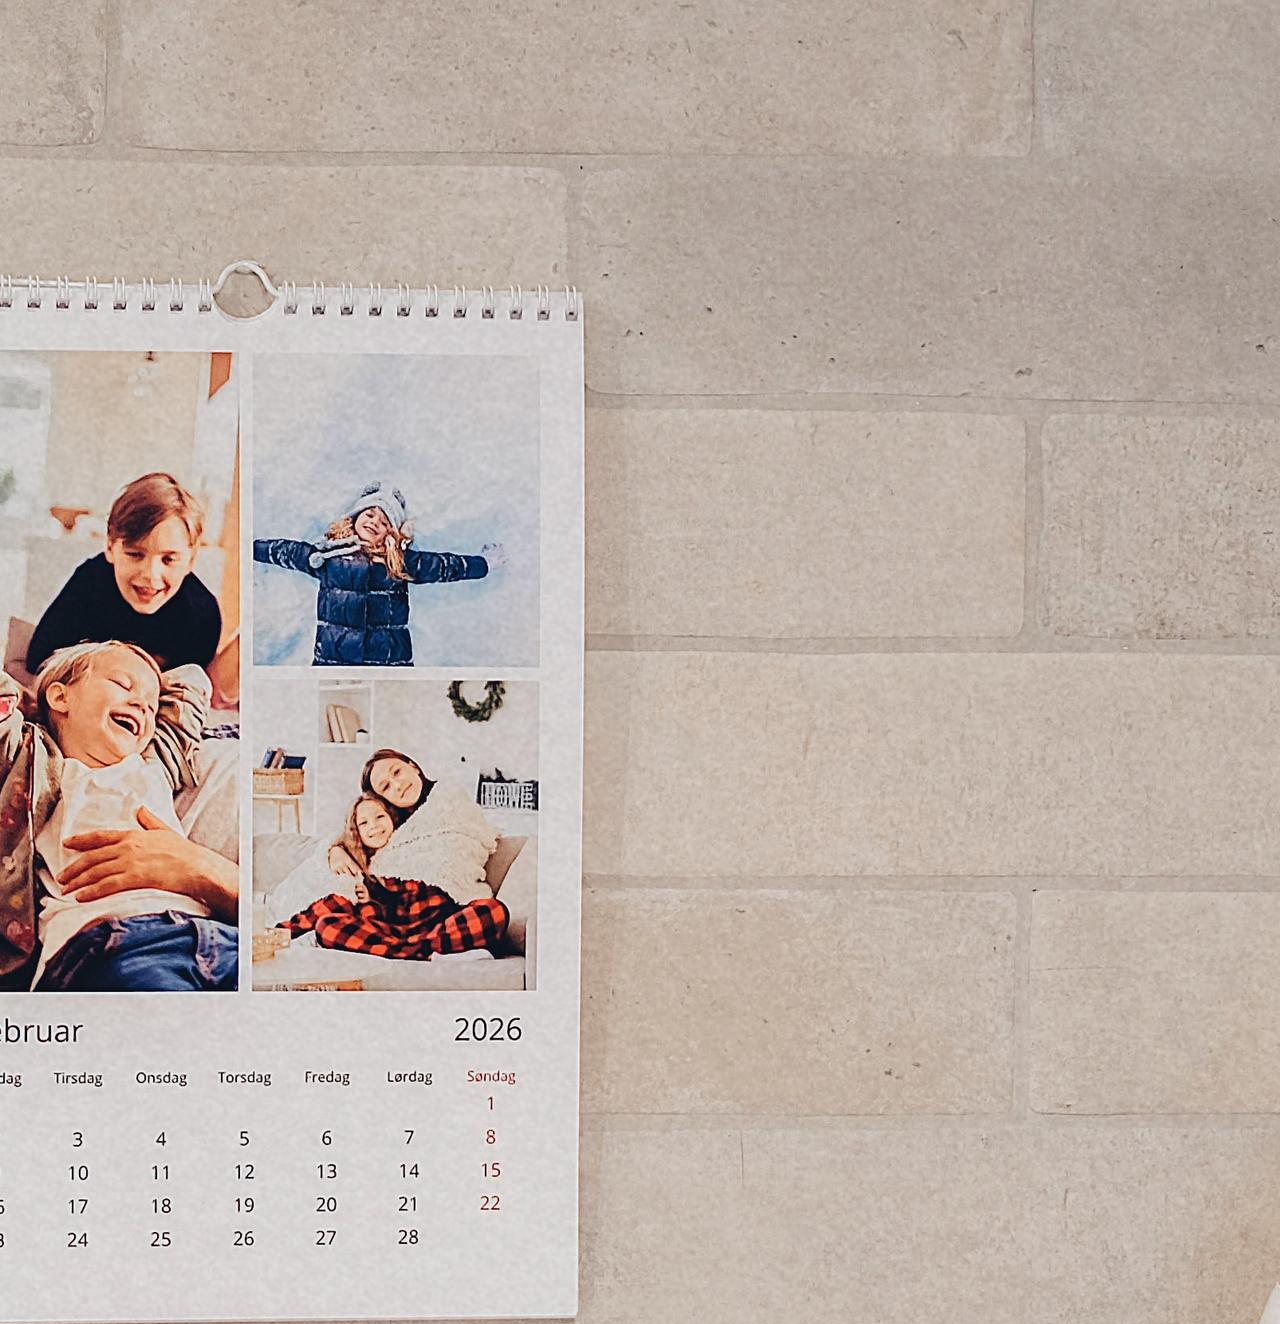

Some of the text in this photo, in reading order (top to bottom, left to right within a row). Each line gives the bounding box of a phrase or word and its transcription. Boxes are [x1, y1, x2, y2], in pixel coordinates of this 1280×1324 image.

[454, 1017, 523, 1042] 2026
[53, 1071, 103, 1088] Tirsdag
[135, 1071, 188, 1088] Onsdag
[217, 1070, 272, 1087] Torsdag
[304, 1070, 351, 1087] Fredag
[387, 1070, 433, 1087] Lørdag
[467, 1069, 516, 1086] Søndag
[487, 1096, 495, 1111] 1
[72, 1131, 83, 1148] 3
[155, 1131, 167, 1147] 4
[239, 1130, 250, 1147] 5
[321, 1129, 332, 1146] 6
[403, 1129, 415, 1145] 7
[485, 1128, 496, 1145] 8
[68, 1165, 89, 1181] 10
[151, 1164, 171, 1181] 11
[235, 1163, 255, 1180] 12
[317, 1163, 337, 1180] 13
[399, 1163, 420, 1179] 14
[481, 1162, 501, 1178] 15
[68, 1198, 89, 1215] 17
[152, 1197, 172, 1214] 18
[235, 1197, 255, 1213] 19
[315, 1196, 338, 1213] 20
[398, 1196, 418, 1212] 21
[480, 1195, 501, 1211] 22
[67, 1232, 89, 1248] 24
[150, 1231, 172, 1248] 25
[233, 1230, 255, 1247] 26
[315, 1230, 337, 1246] 27
[397, 1228, 419, 1245] 28
